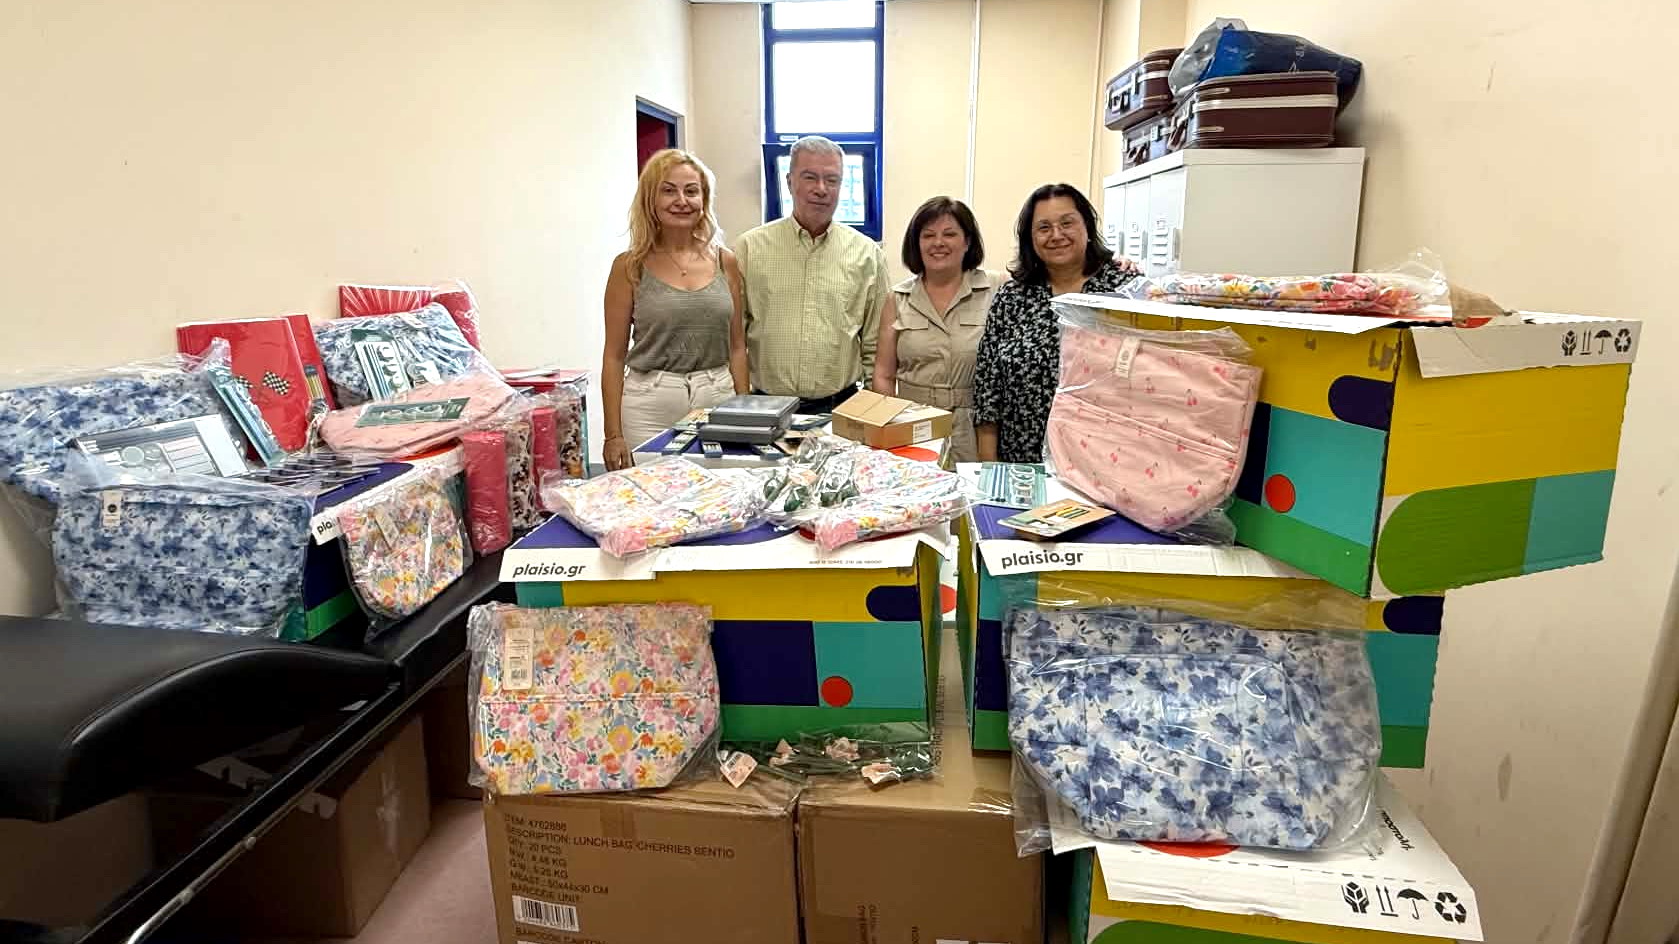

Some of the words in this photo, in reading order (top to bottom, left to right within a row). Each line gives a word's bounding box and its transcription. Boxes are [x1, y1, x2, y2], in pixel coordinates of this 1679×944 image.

[1001, 549, 1084, 569] plaisio.gr
[512, 562, 586, 578] plaisio.gr
[573, 836, 609, 848] LUNCH
[612, 839, 633, 850] BAG
